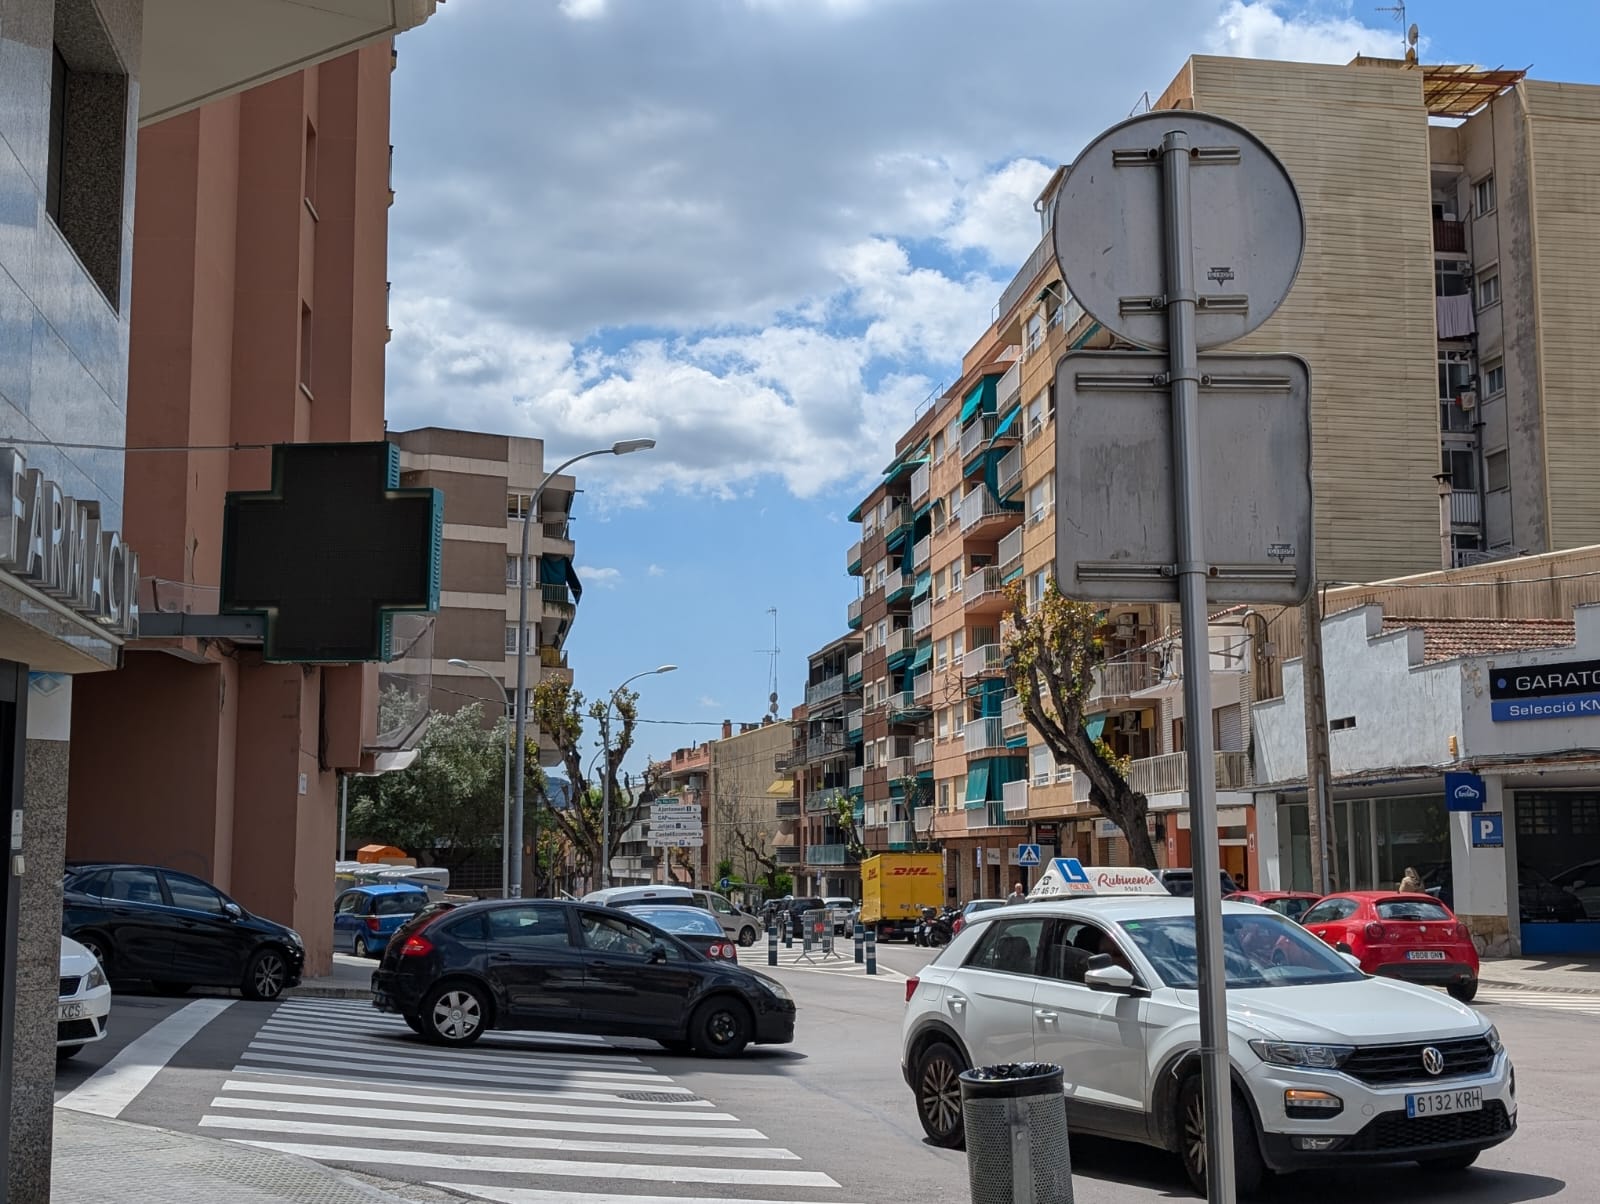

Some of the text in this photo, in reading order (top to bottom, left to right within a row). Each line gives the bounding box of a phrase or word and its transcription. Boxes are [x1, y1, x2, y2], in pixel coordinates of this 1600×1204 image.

[8, 448, 139, 640] FARMACIA
[1509, 701, 1576, 716] Selecció
[1480, 820, 1494, 840] P
[893, 867, 929, 876] DHL
[1097, 873, 1156, 888] Rubinense
[1050, 887, 1059, 895] 31
[61, 1004, 81, 1018] KCS
[1417, 1090, 1480, 1112] 6132 KRH
